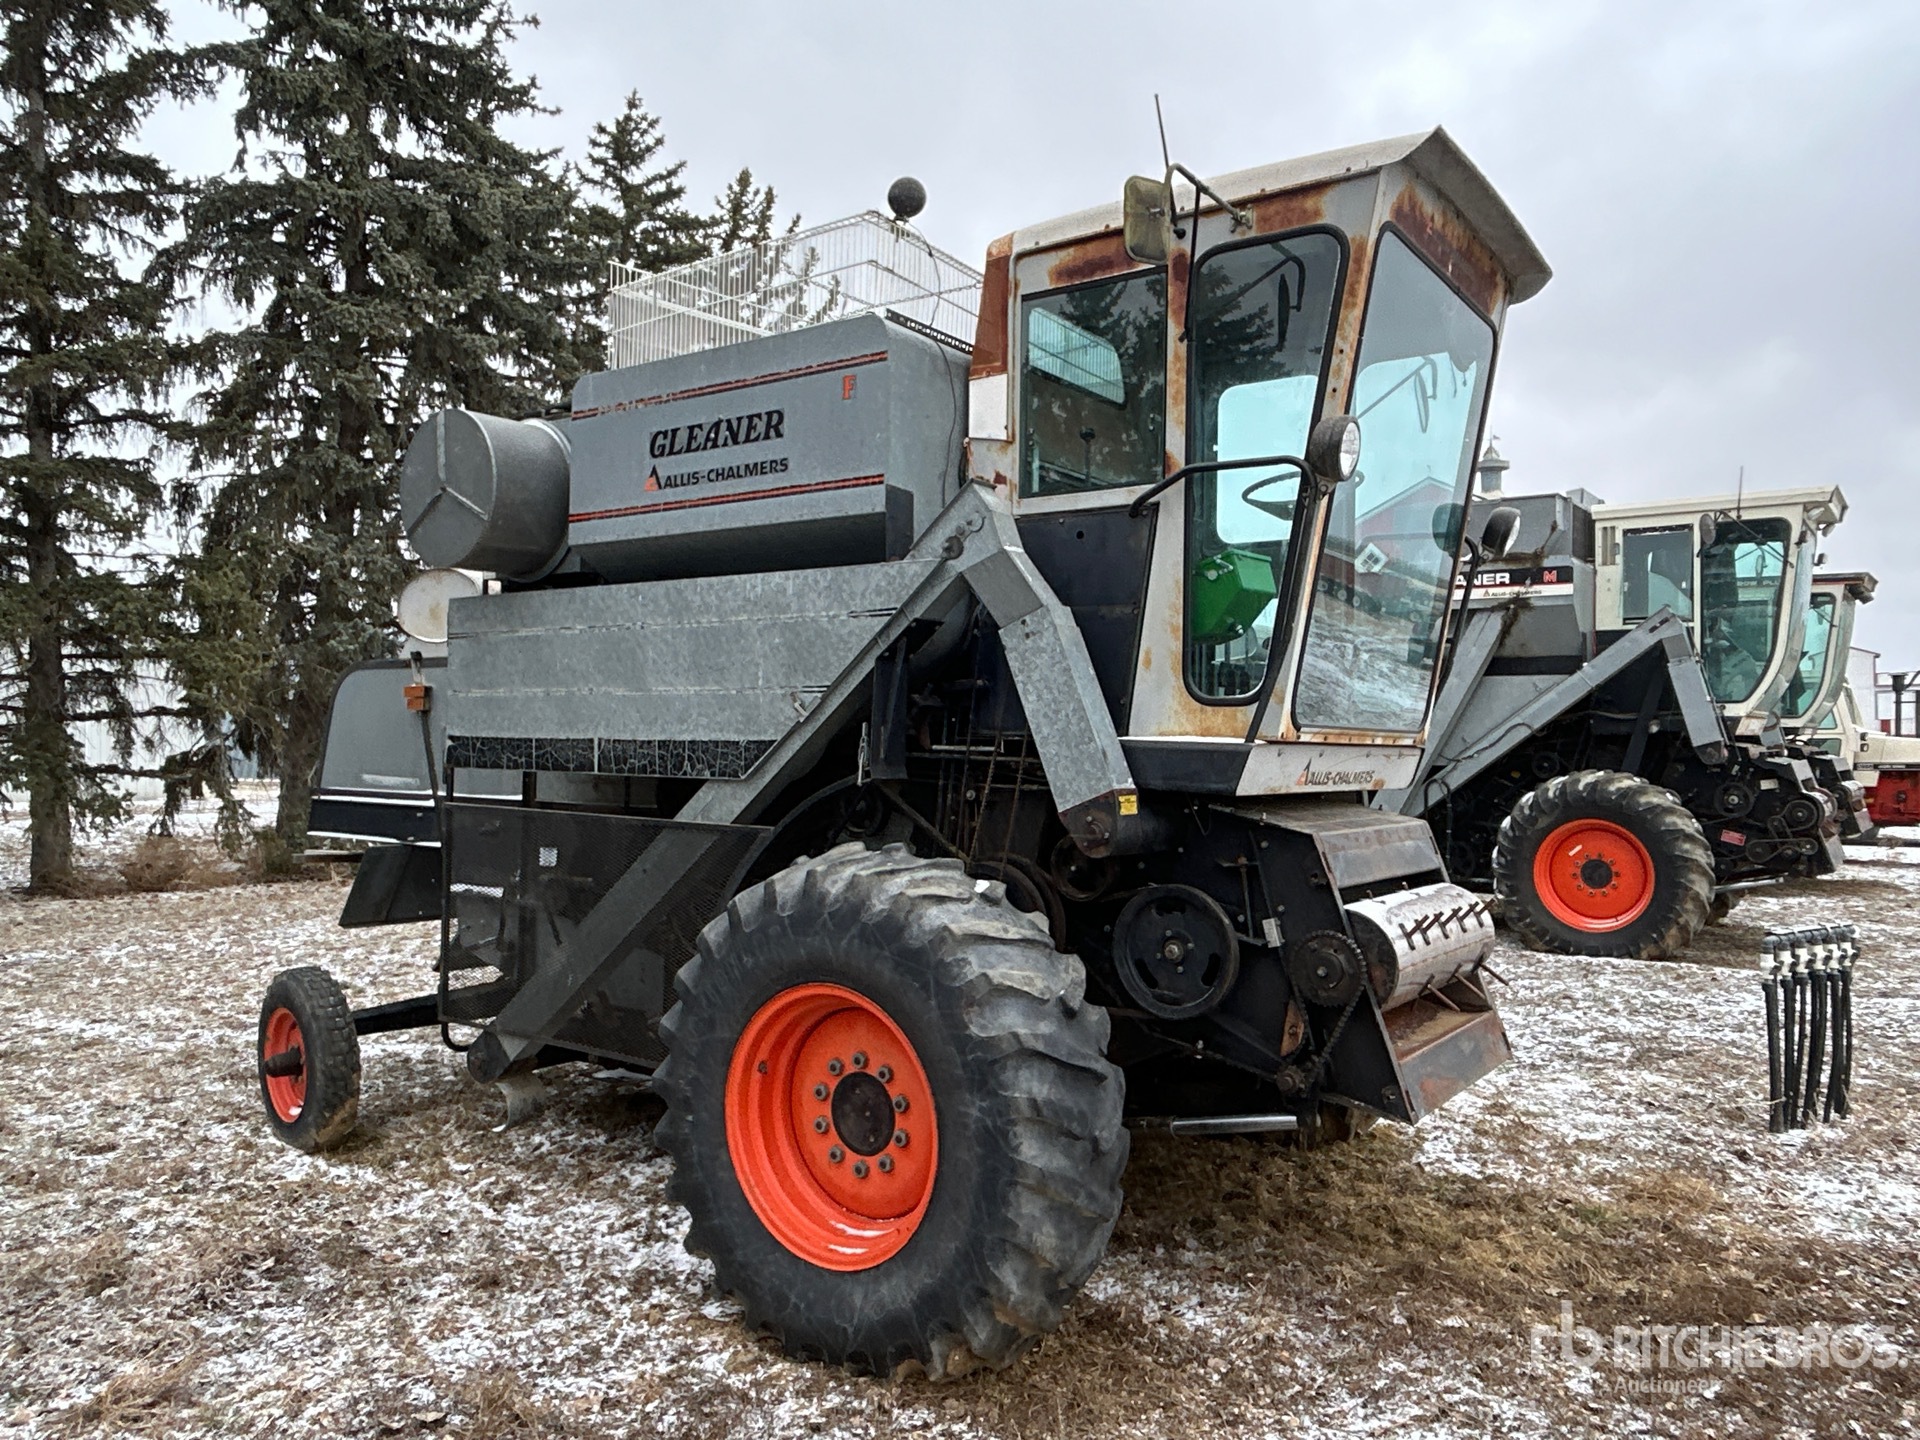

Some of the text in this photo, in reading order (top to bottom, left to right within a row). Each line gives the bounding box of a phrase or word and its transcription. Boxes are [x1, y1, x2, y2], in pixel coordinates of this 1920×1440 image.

[842, 374, 857, 400] F
[649, 408, 785, 459] GLEANER
[663, 458, 789, 489] ALLIS-CHALMERS
[1455, 570, 1558, 586] ANER M
[1308, 770, 1375, 785] ALLIS-CHALMERS
